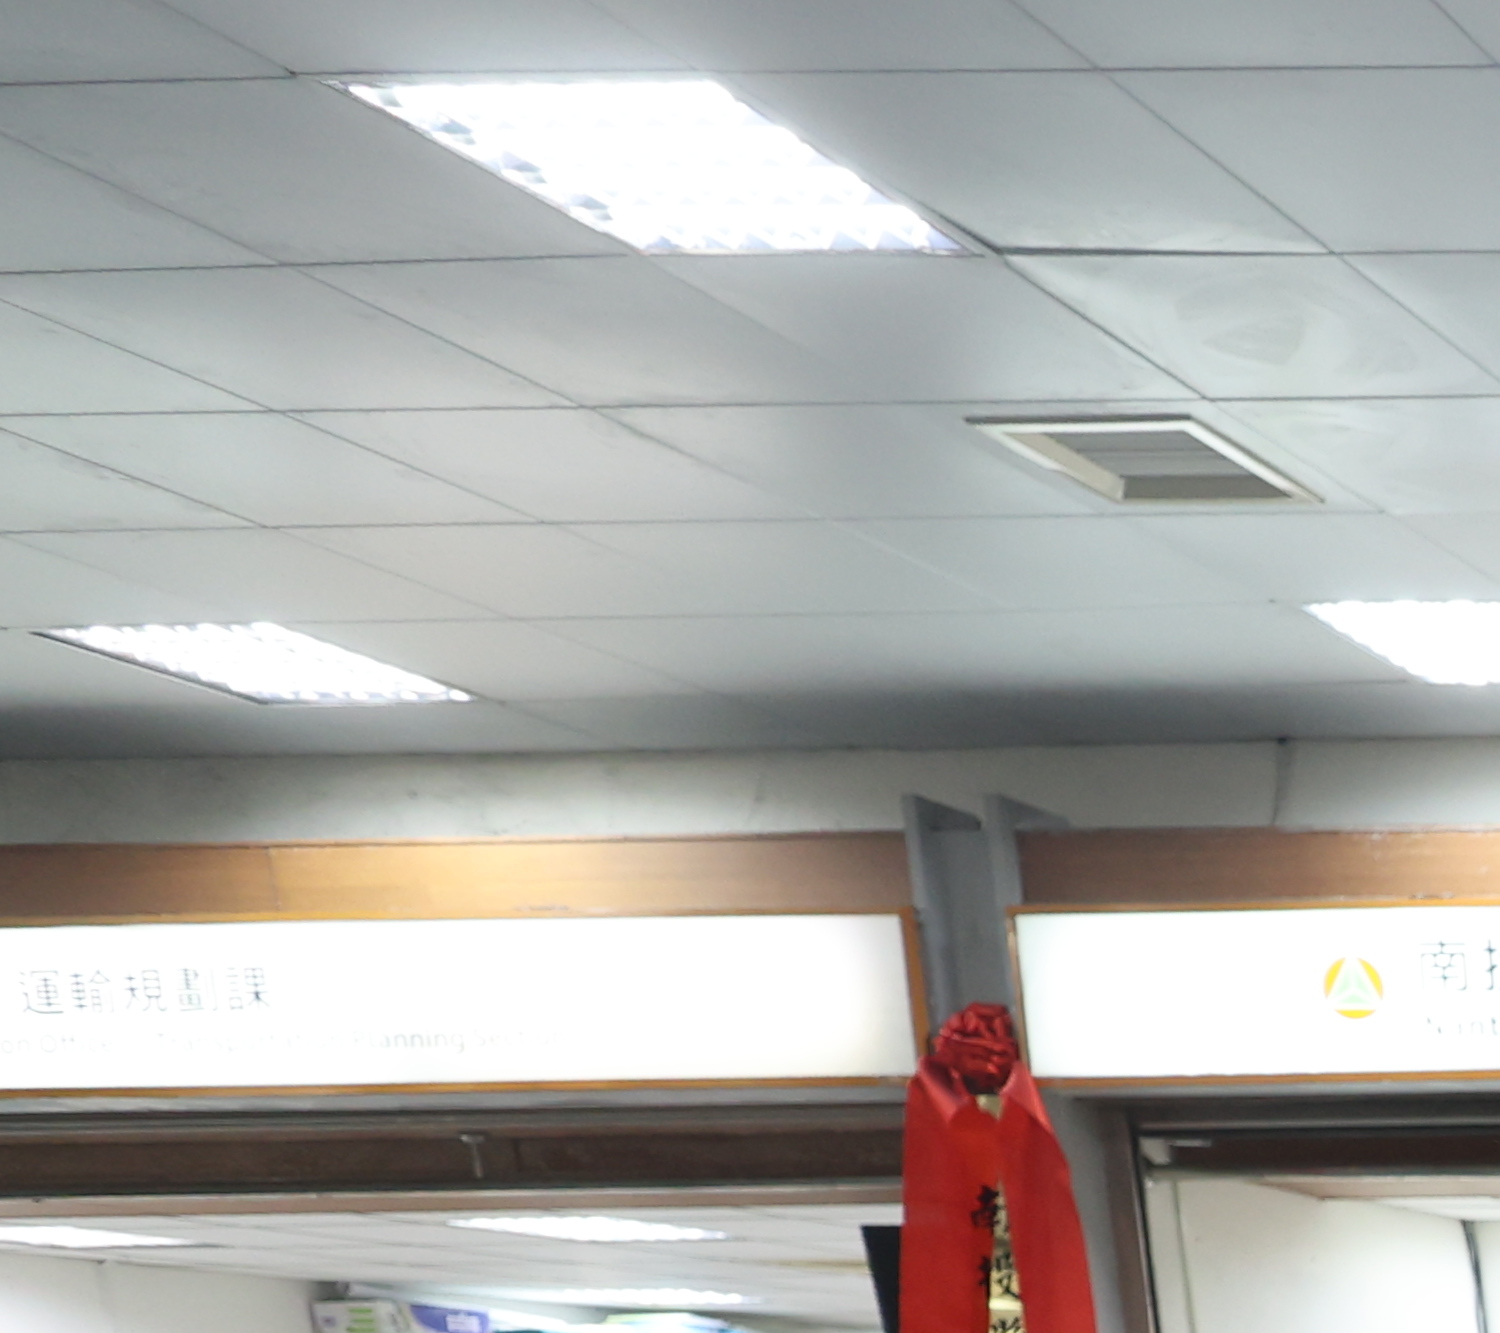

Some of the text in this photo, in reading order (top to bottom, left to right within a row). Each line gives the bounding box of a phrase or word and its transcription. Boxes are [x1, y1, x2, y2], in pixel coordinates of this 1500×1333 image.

[19, 967, 271, 1015] 運輸規劃課
